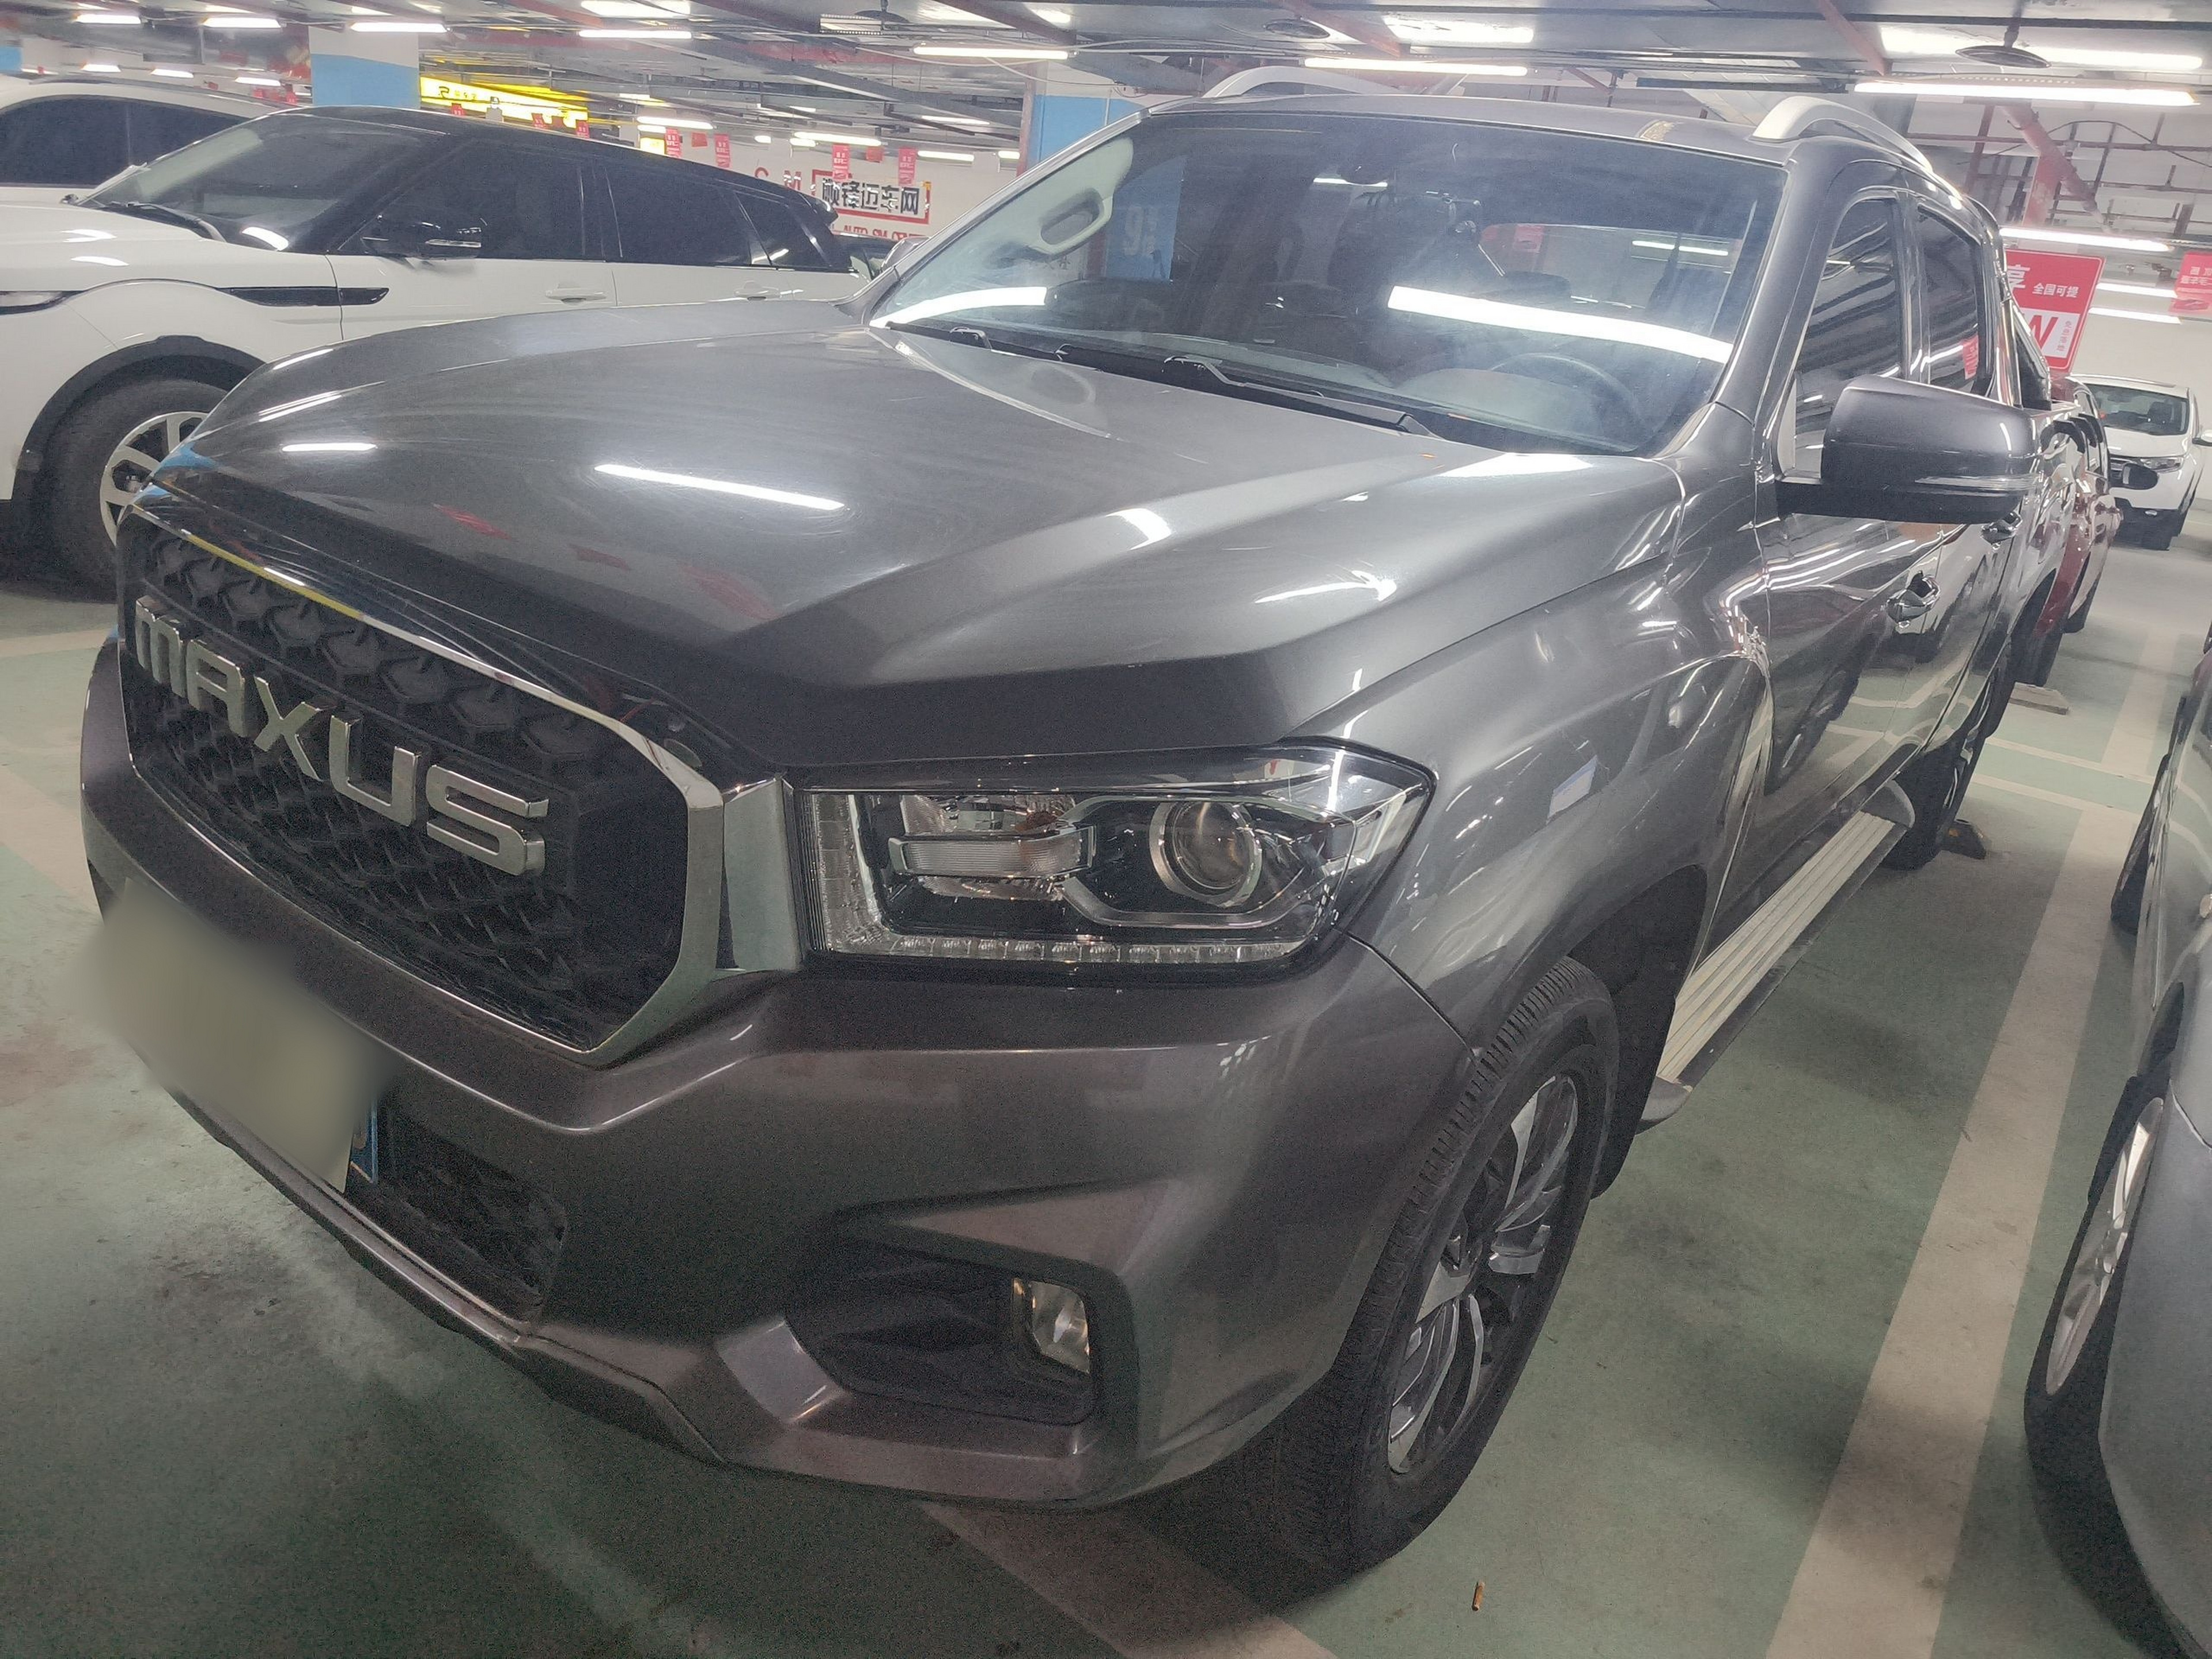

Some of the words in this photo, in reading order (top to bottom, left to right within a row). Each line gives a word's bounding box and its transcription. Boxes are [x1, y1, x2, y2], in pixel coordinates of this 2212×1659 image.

[2032, 282, 2080, 298] 全国可提
[135, 595, 549, 876] MAXUS
